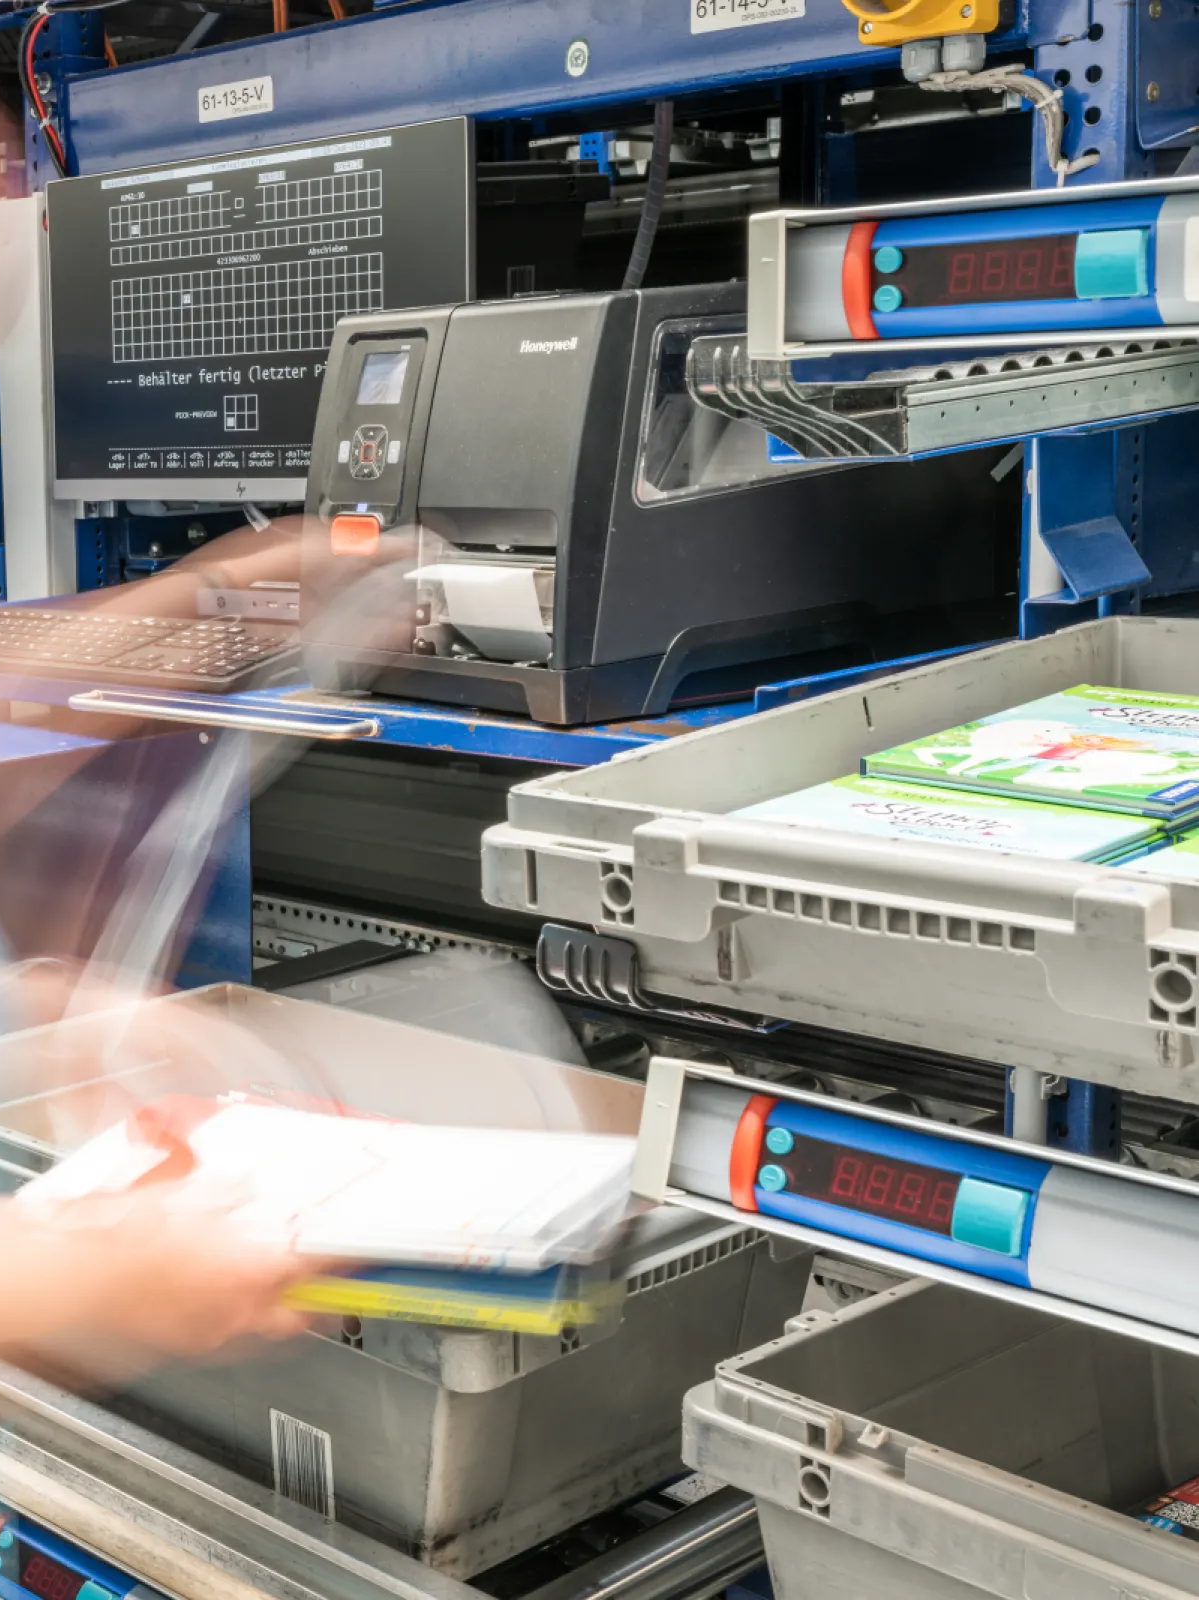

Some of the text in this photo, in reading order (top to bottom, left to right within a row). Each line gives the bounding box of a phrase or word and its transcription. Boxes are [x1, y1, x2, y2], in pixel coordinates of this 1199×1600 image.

[202, 84, 264, 111] 61-13-5-V
[520, 336, 578, 355] Honeywell
[138, 370, 193, 387] Behälter
[198, 367, 241, 385] fertig
[248, 365, 307, 383] (letzter
